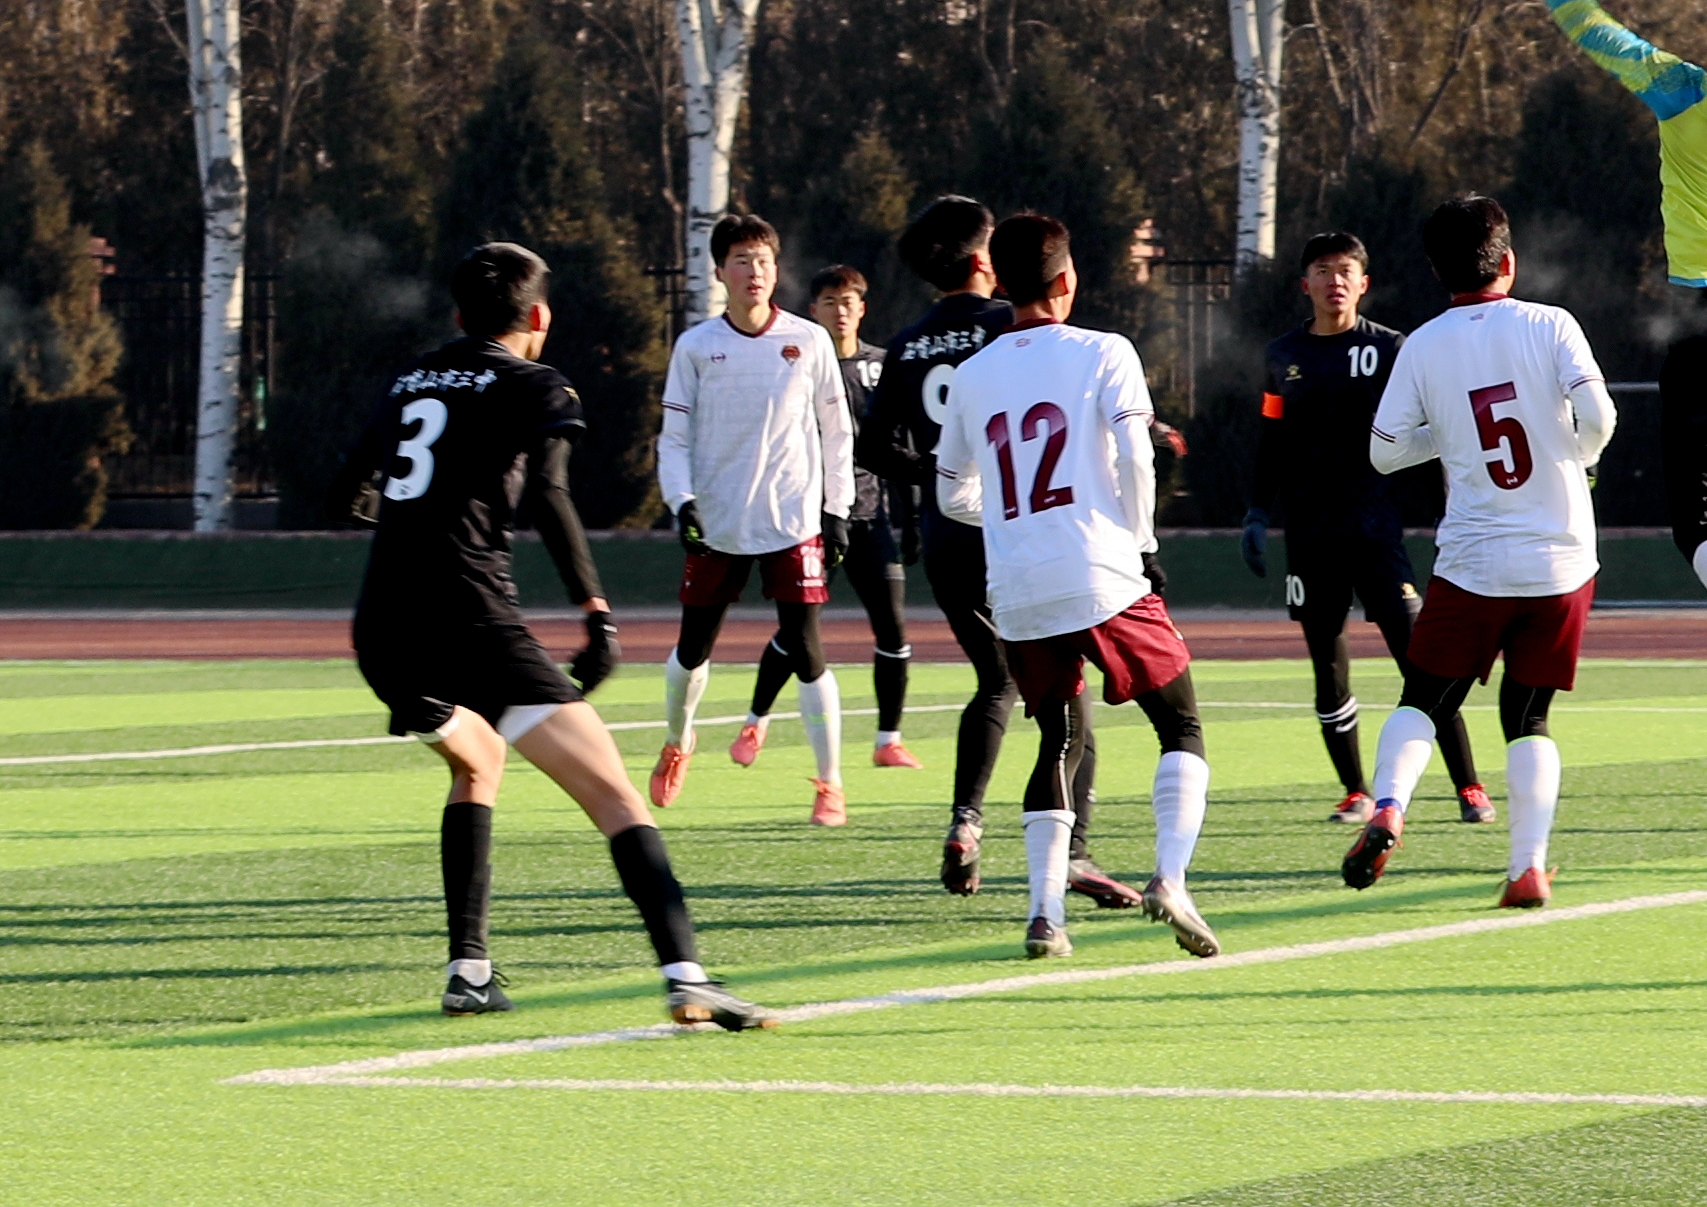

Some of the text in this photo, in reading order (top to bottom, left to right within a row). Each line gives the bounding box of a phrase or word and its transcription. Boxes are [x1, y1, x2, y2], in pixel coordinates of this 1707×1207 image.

[856, 360, 883, 387] 19
[1347, 345, 1379, 377] 10
[383, 397, 448, 502] 3
[985, 401, 1075, 521] 12
[1467, 380, 1533, 490] 5
[1285, 573, 1305, 607] 10
